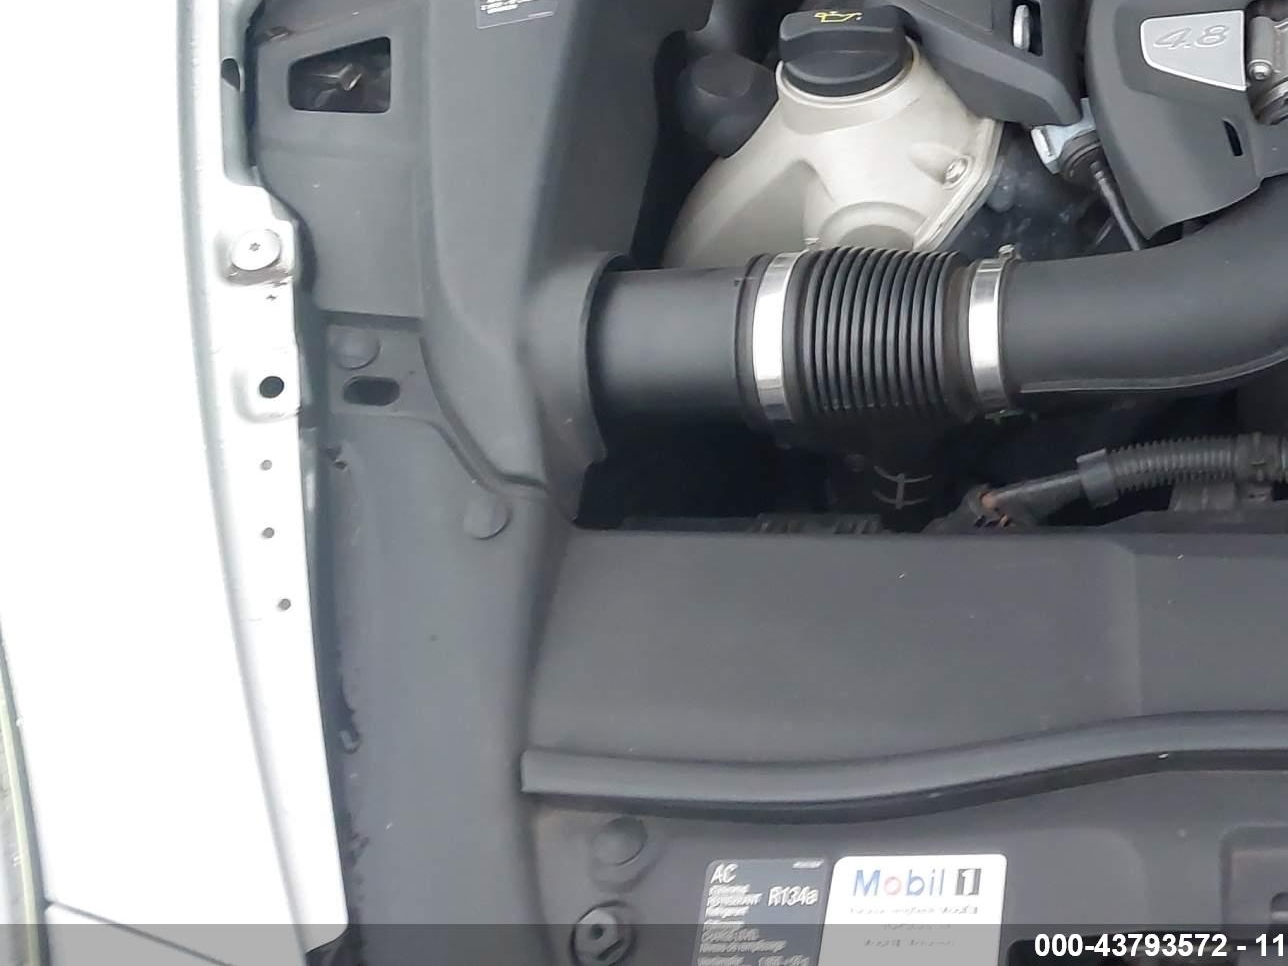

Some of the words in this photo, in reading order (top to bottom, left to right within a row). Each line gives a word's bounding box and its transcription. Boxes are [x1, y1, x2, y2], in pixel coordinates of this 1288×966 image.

[1153, 24, 1231, 50] 4.8
[711, 863, 739, 884] AC
[852, 867, 945, 896] Mobil
[955, 867, 982, 896] 1
